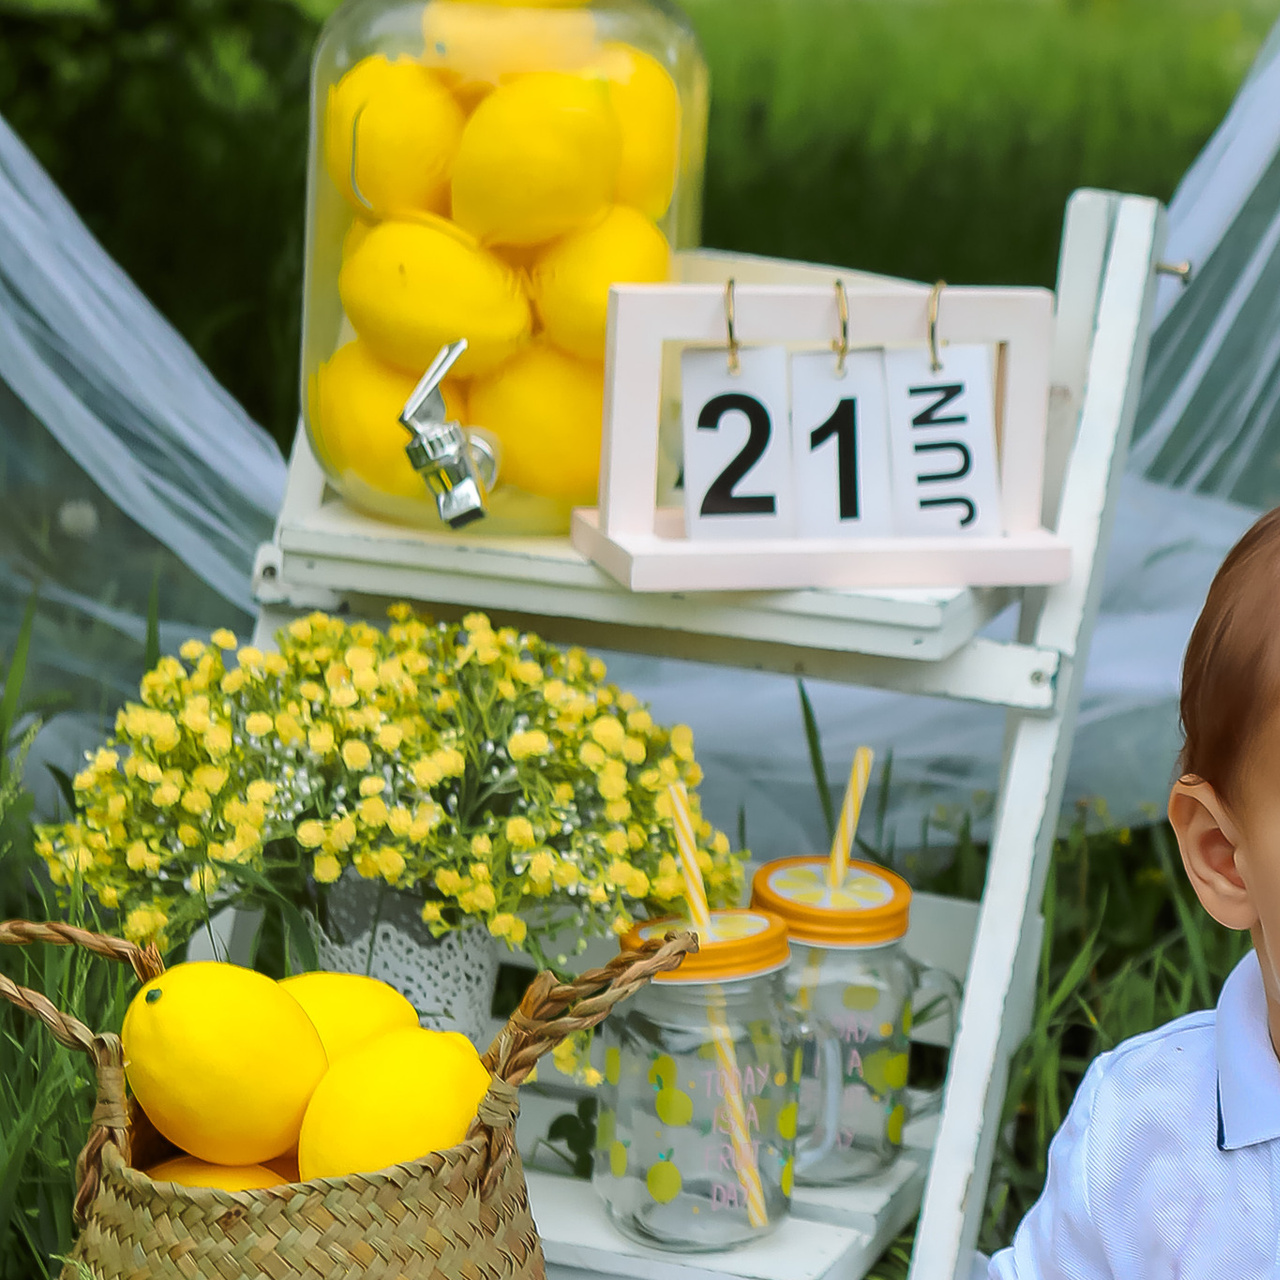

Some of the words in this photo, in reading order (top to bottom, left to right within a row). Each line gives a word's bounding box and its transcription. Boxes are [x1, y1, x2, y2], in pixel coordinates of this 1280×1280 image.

[908, 382, 977, 527] JUN
[701, 1063, 770, 1098] TODAY
[712, 1105, 736, 1134] IS
[744, 1102, 760, 1132] A
